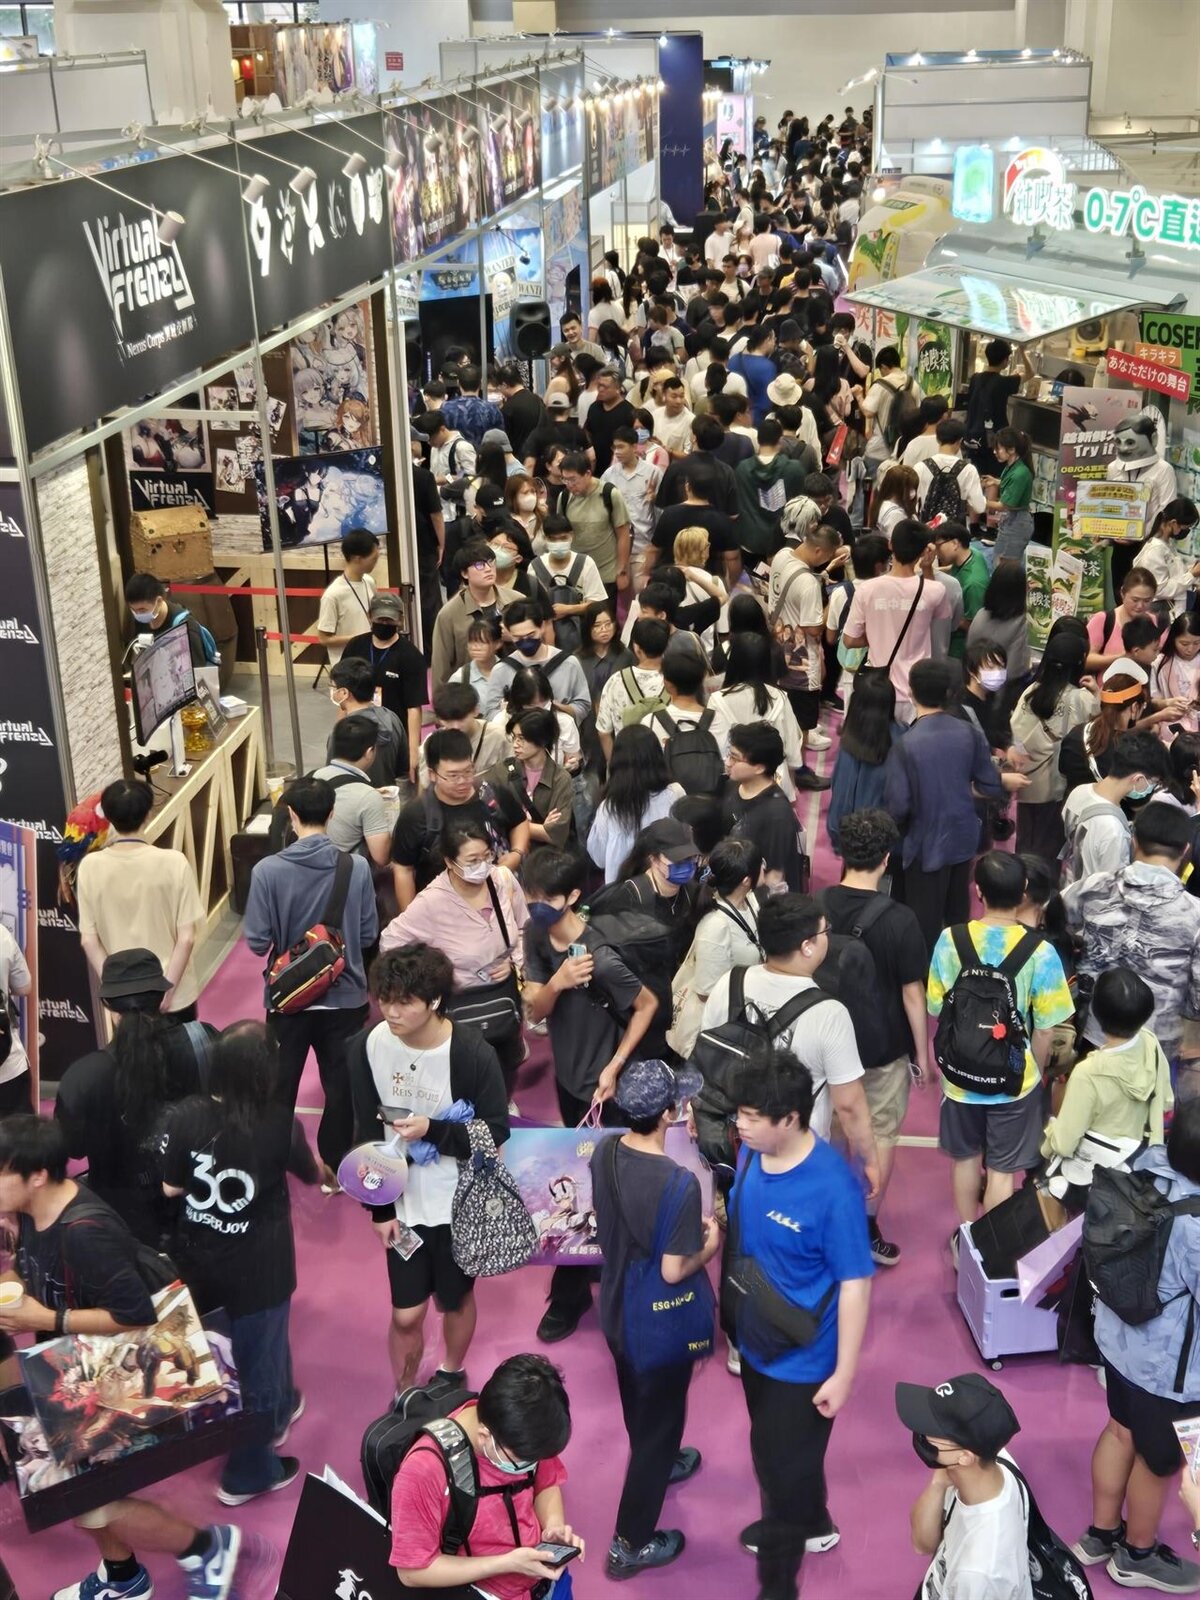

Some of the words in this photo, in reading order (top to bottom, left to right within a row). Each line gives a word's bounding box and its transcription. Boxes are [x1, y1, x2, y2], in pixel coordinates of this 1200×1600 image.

[1014, 177, 1077, 229] 純喫茶
[485, 255, 516, 275] WANTED
[111, 240, 195, 337] Frenzy
[920, 347, 950, 373] 純喫茶
[1139, 347, 1177, 364] キラキラ
[1108, 354, 1187, 393] あなただけの舞台
[1073, 444, 1100, 458] Try
[1102, 442, 1115, 456] it
[134, 479, 188, 503] Virtual
[947, 1063, 998, 1084] SUPREME
